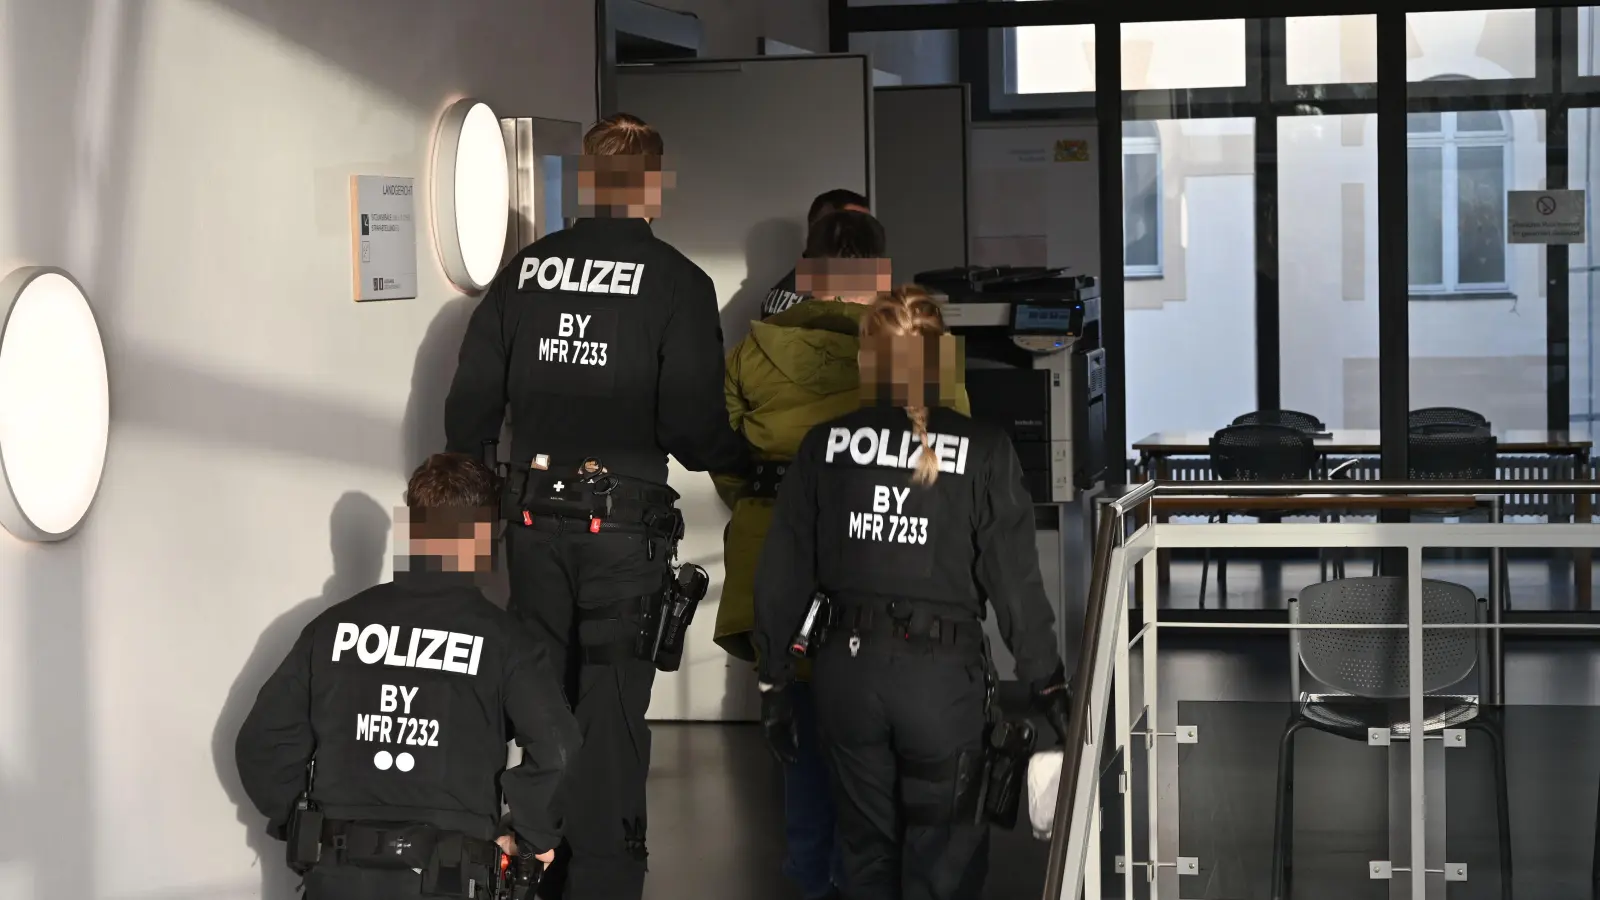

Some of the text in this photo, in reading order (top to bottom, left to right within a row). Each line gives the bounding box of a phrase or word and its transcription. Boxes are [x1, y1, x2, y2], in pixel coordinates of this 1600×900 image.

[518, 256, 645, 296] POLIZEI
[558, 313, 592, 339] BY
[538, 337, 608, 367] MFR 7233
[825, 426, 970, 475] POLIZEI
[873, 484, 911, 514] BY
[849, 511, 929, 545] MFR 7233
[331, 622, 485, 676] POLIZEI
[380, 684, 420, 714] BY
[356, 713, 440, 747] MFR 7232
